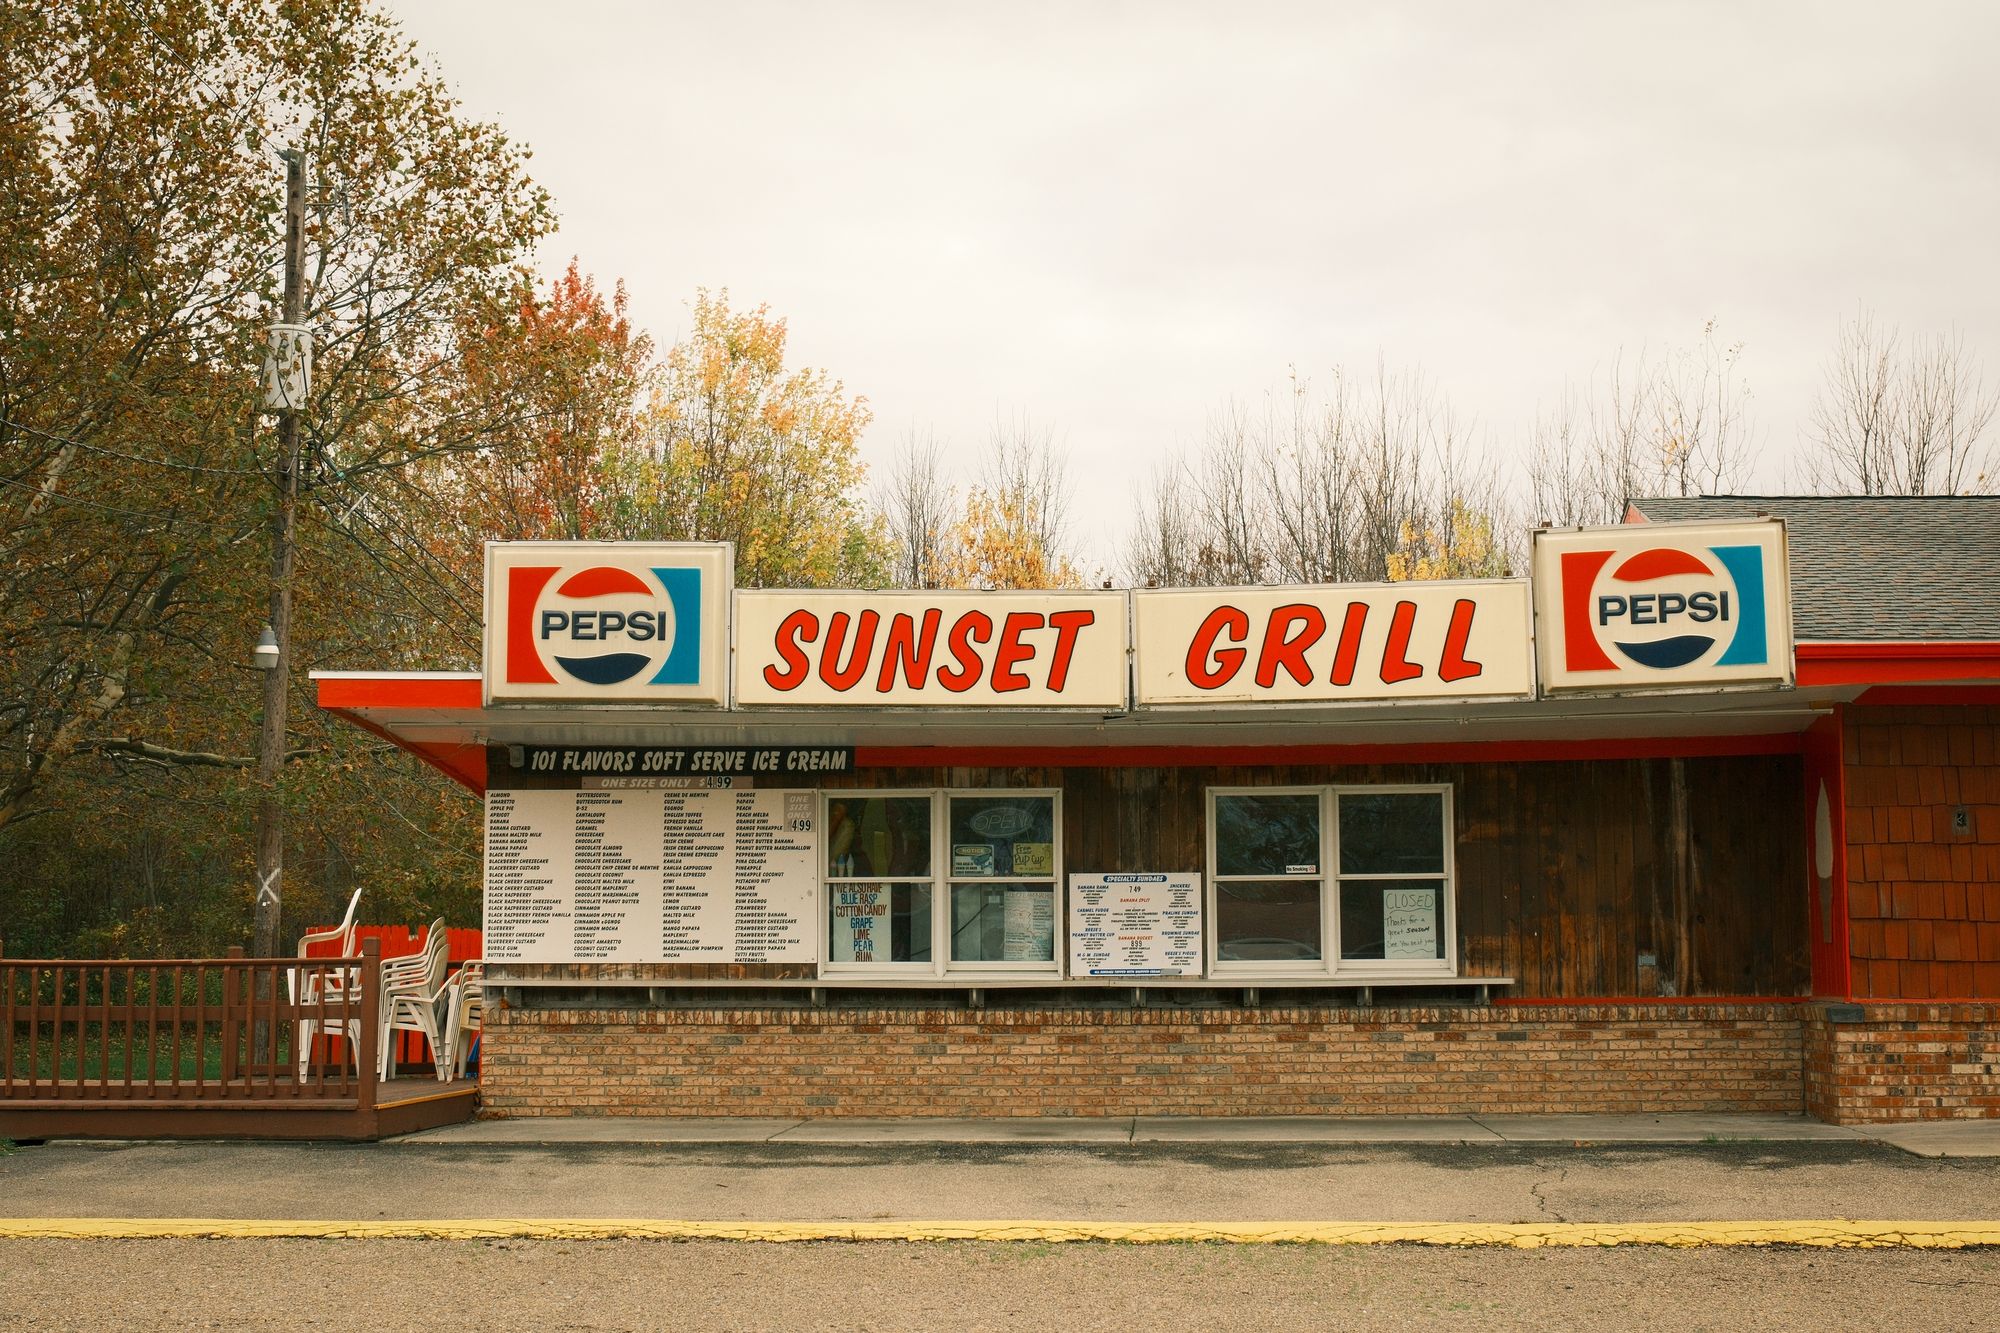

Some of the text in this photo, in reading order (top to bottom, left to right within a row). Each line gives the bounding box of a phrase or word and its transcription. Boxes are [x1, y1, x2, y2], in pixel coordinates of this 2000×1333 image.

[1598, 590, 1730, 626] PEPSI
[541, 610, 666, 642] PEPSI
[763, 598, 1482, 694] SUNSET GRILL
[532, 750, 846, 772] 101 FLAVORS SOFT SERVE ICE CREAM
[602, 778, 624, 788] ONE
[630, 778, 656, 788] SIZE
[660, 778, 691, 788] ONLY
[974, 815, 1028, 830] OPEN
[841, 894, 877, 904] BLUE RASP
[1386, 893, 1433, 909] CLOSED
[836, 904, 887, 917] COTTON CANDY
[851, 917, 873, 928] GRAPE
[854, 929, 870, 940] LIME
[854, 940, 873, 951] PEAR
[856, 952, 872, 962] RUM
